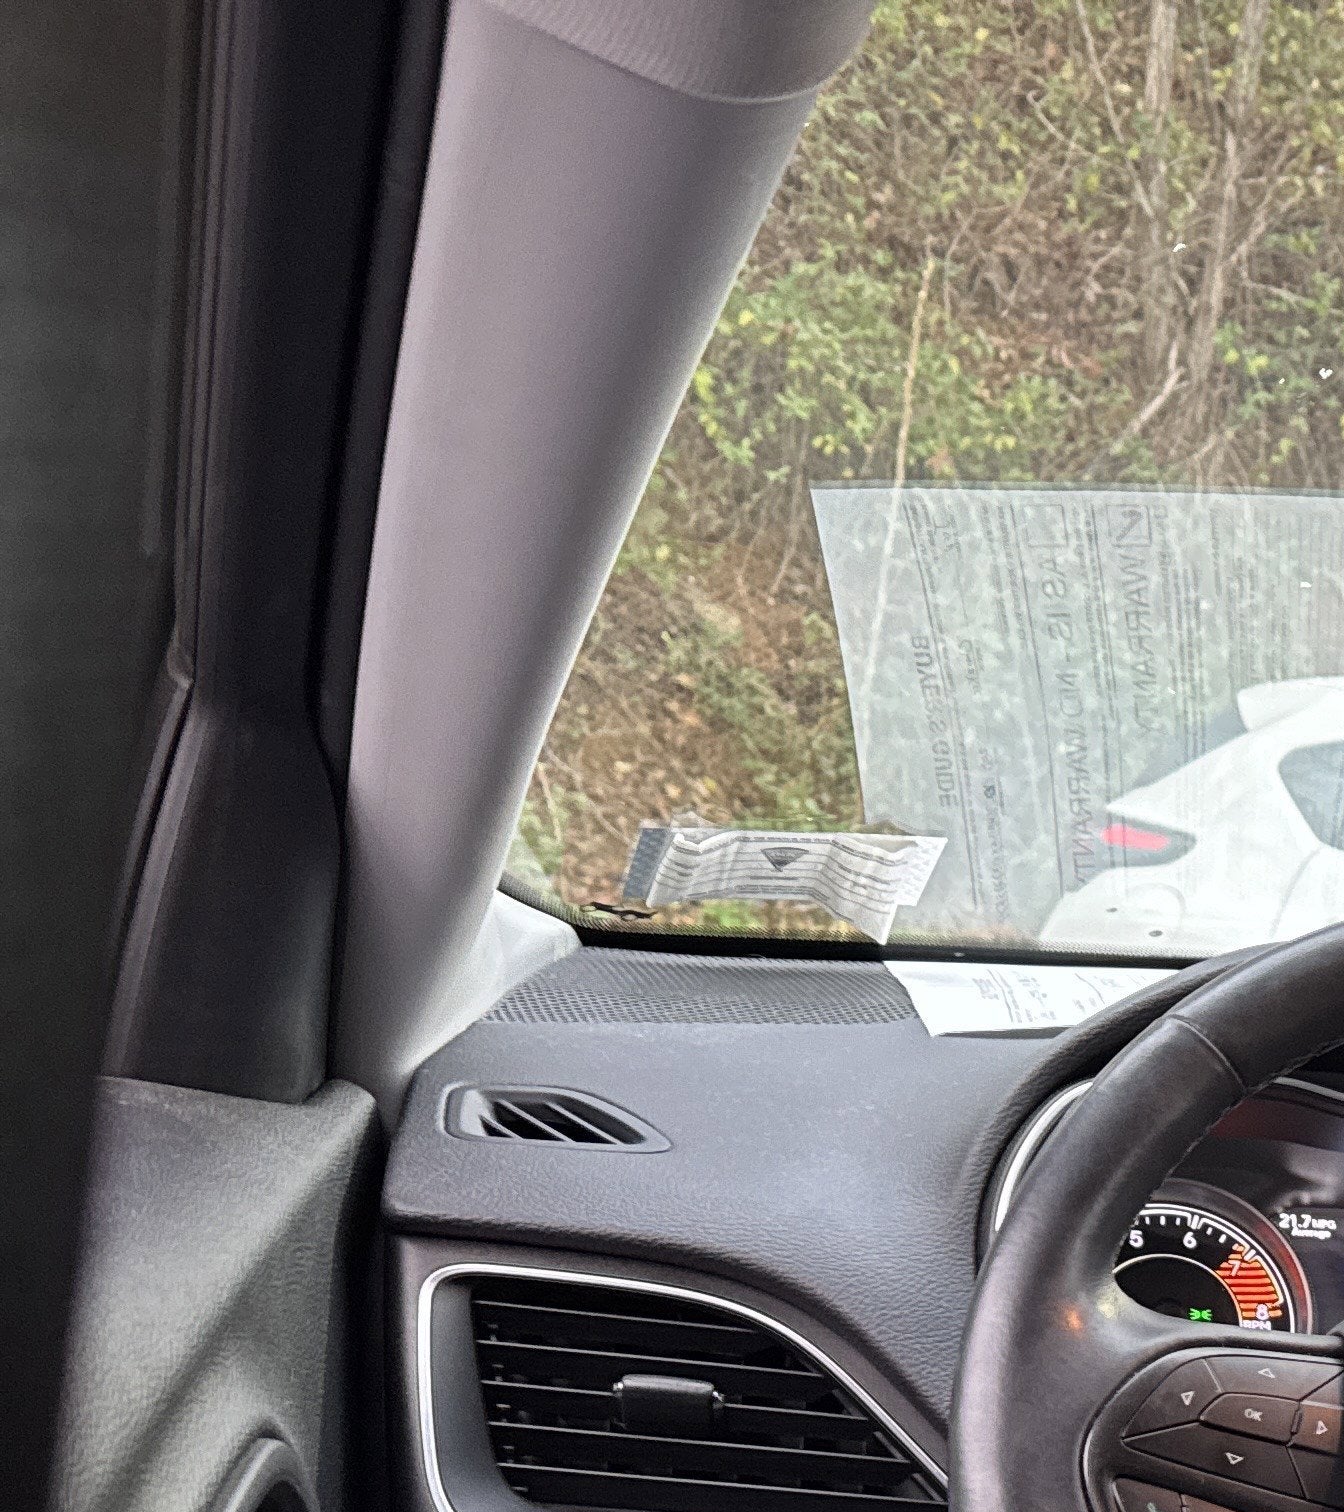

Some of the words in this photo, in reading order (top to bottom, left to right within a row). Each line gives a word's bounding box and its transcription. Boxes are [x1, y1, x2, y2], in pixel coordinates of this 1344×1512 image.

[1279, 1213, 1311, 1229] 21.7
[1129, 1230, 1144, 1248] 5
[1183, 1232, 1198, 1248] 6
[1229, 1260, 1241, 1277] 7
[1256, 1303, 1269, 1320] 8
[1244, 1408, 1263, 1422] OK
